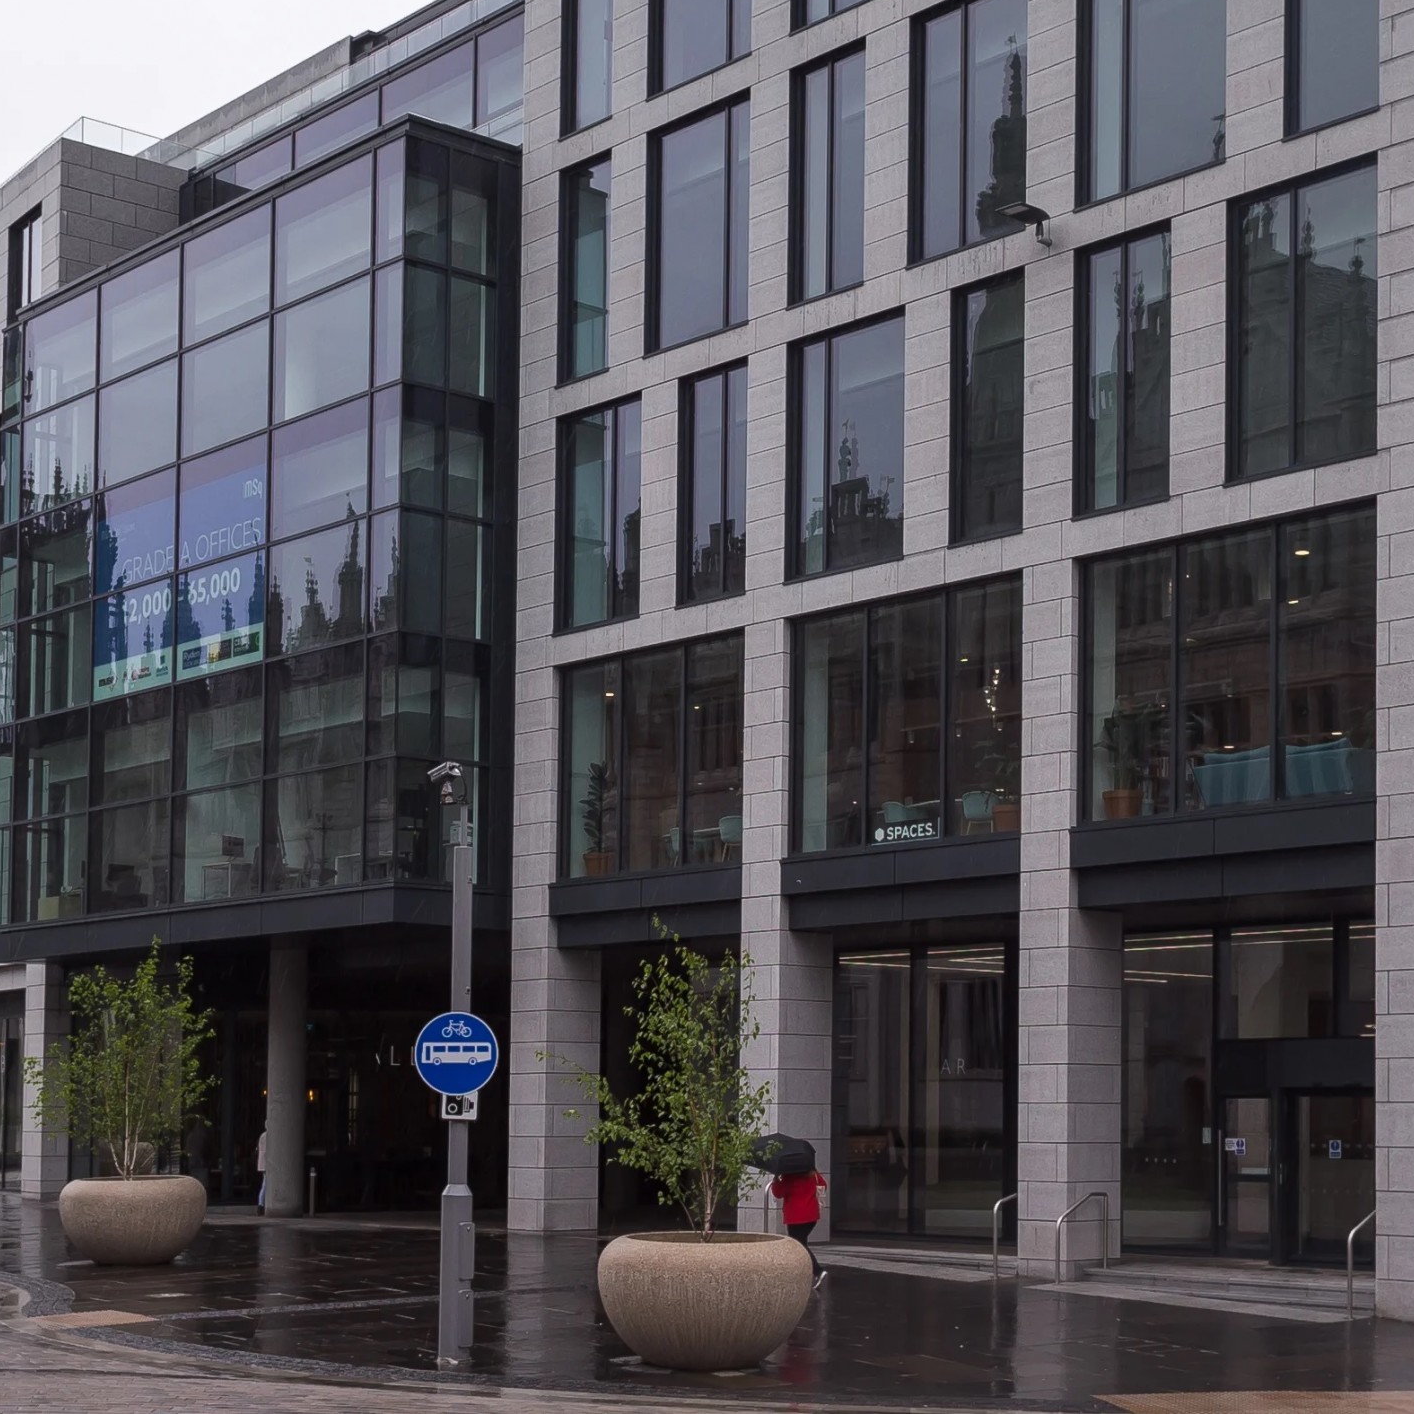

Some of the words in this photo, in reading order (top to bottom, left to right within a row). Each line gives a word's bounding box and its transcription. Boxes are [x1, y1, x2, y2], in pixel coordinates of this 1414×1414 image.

[121, 544, 175, 584] GRADE
[195, 517, 262, 561] OFFICES
[187, 567, 241, 606] 65,000
